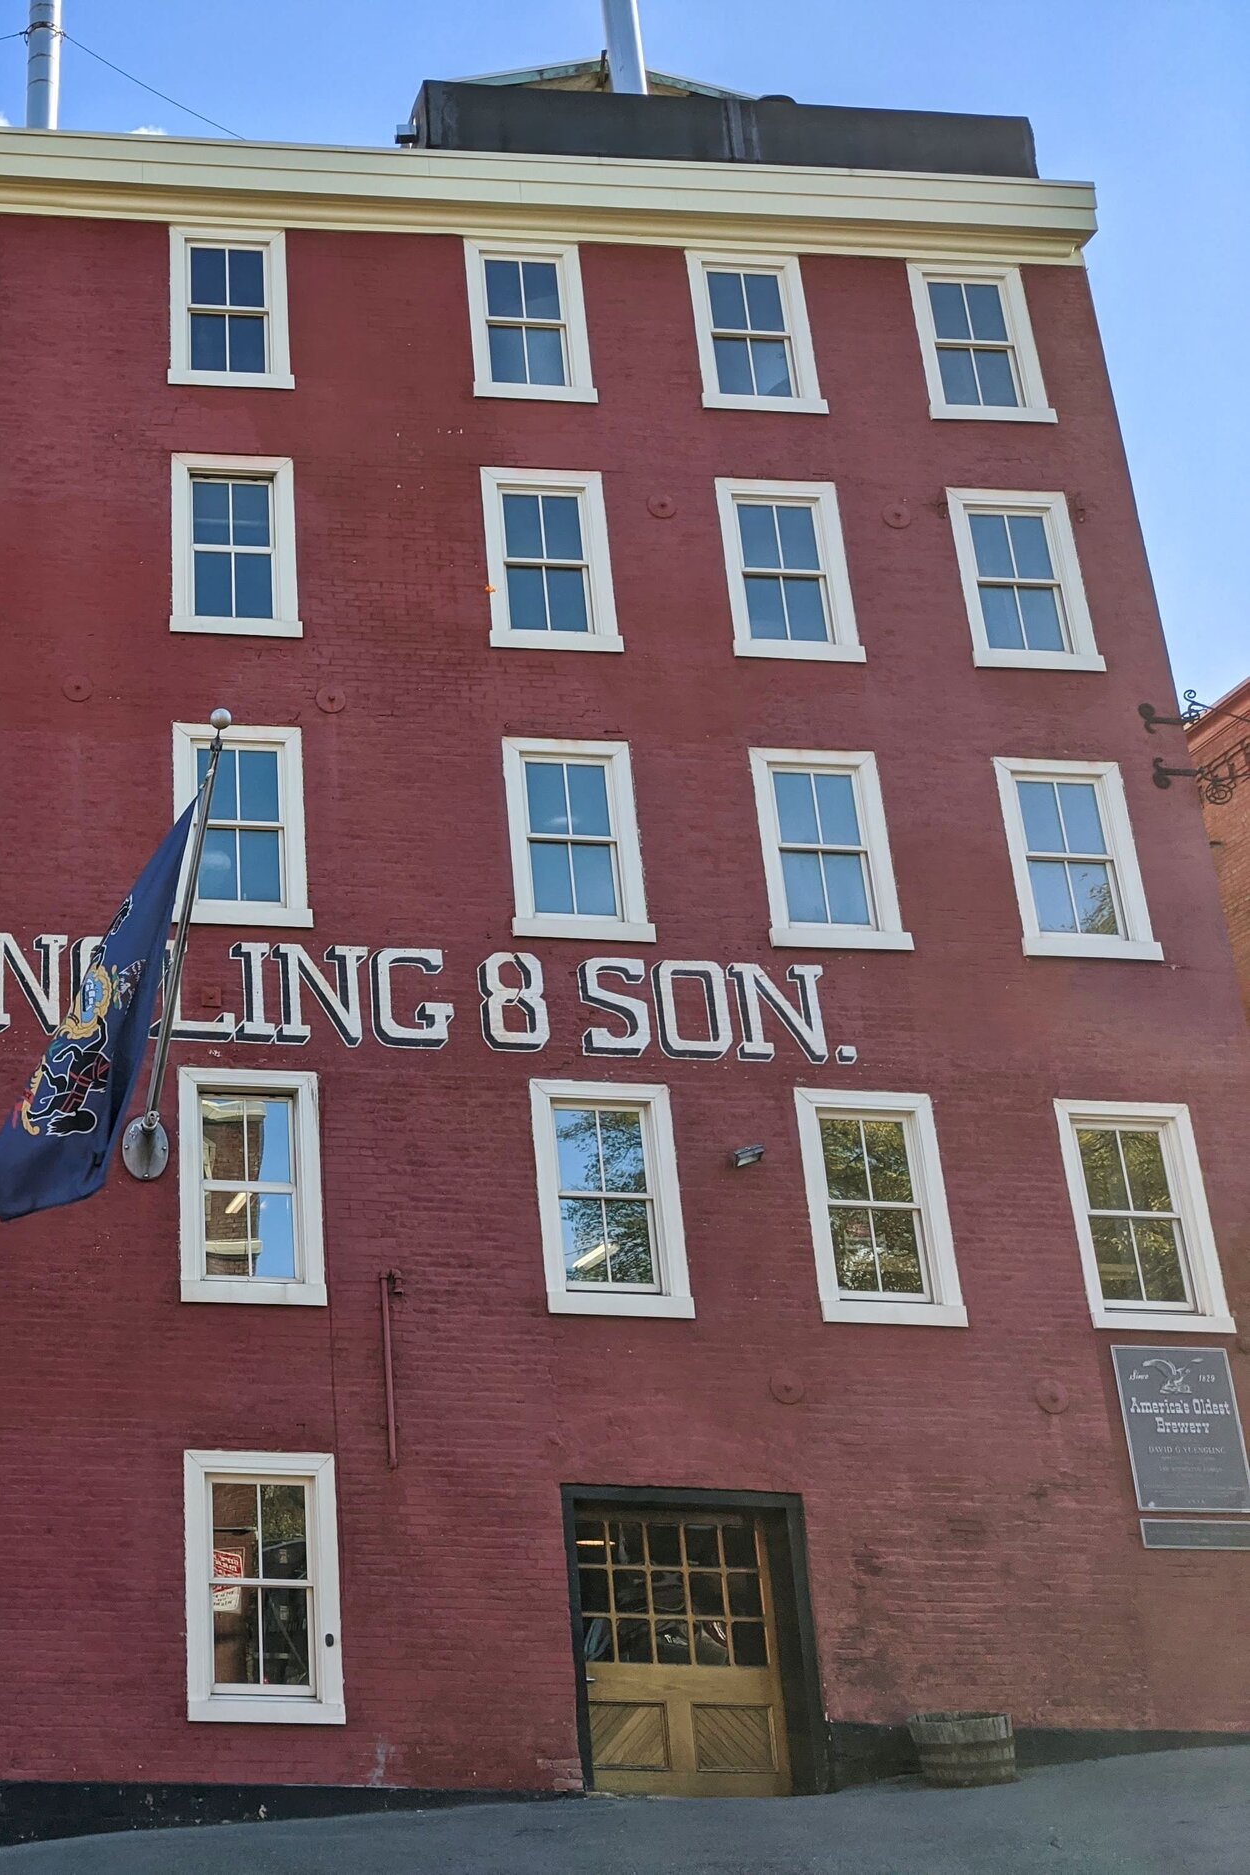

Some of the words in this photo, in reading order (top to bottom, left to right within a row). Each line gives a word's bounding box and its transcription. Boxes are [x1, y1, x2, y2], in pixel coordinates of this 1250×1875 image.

[578, 956, 858, 1065] SON.
[1130, 1397, 1190, 1414] America's
[1192, 1398, 1231, 1416] Oldest
[1155, 1416, 1210, 1434] Brewery
